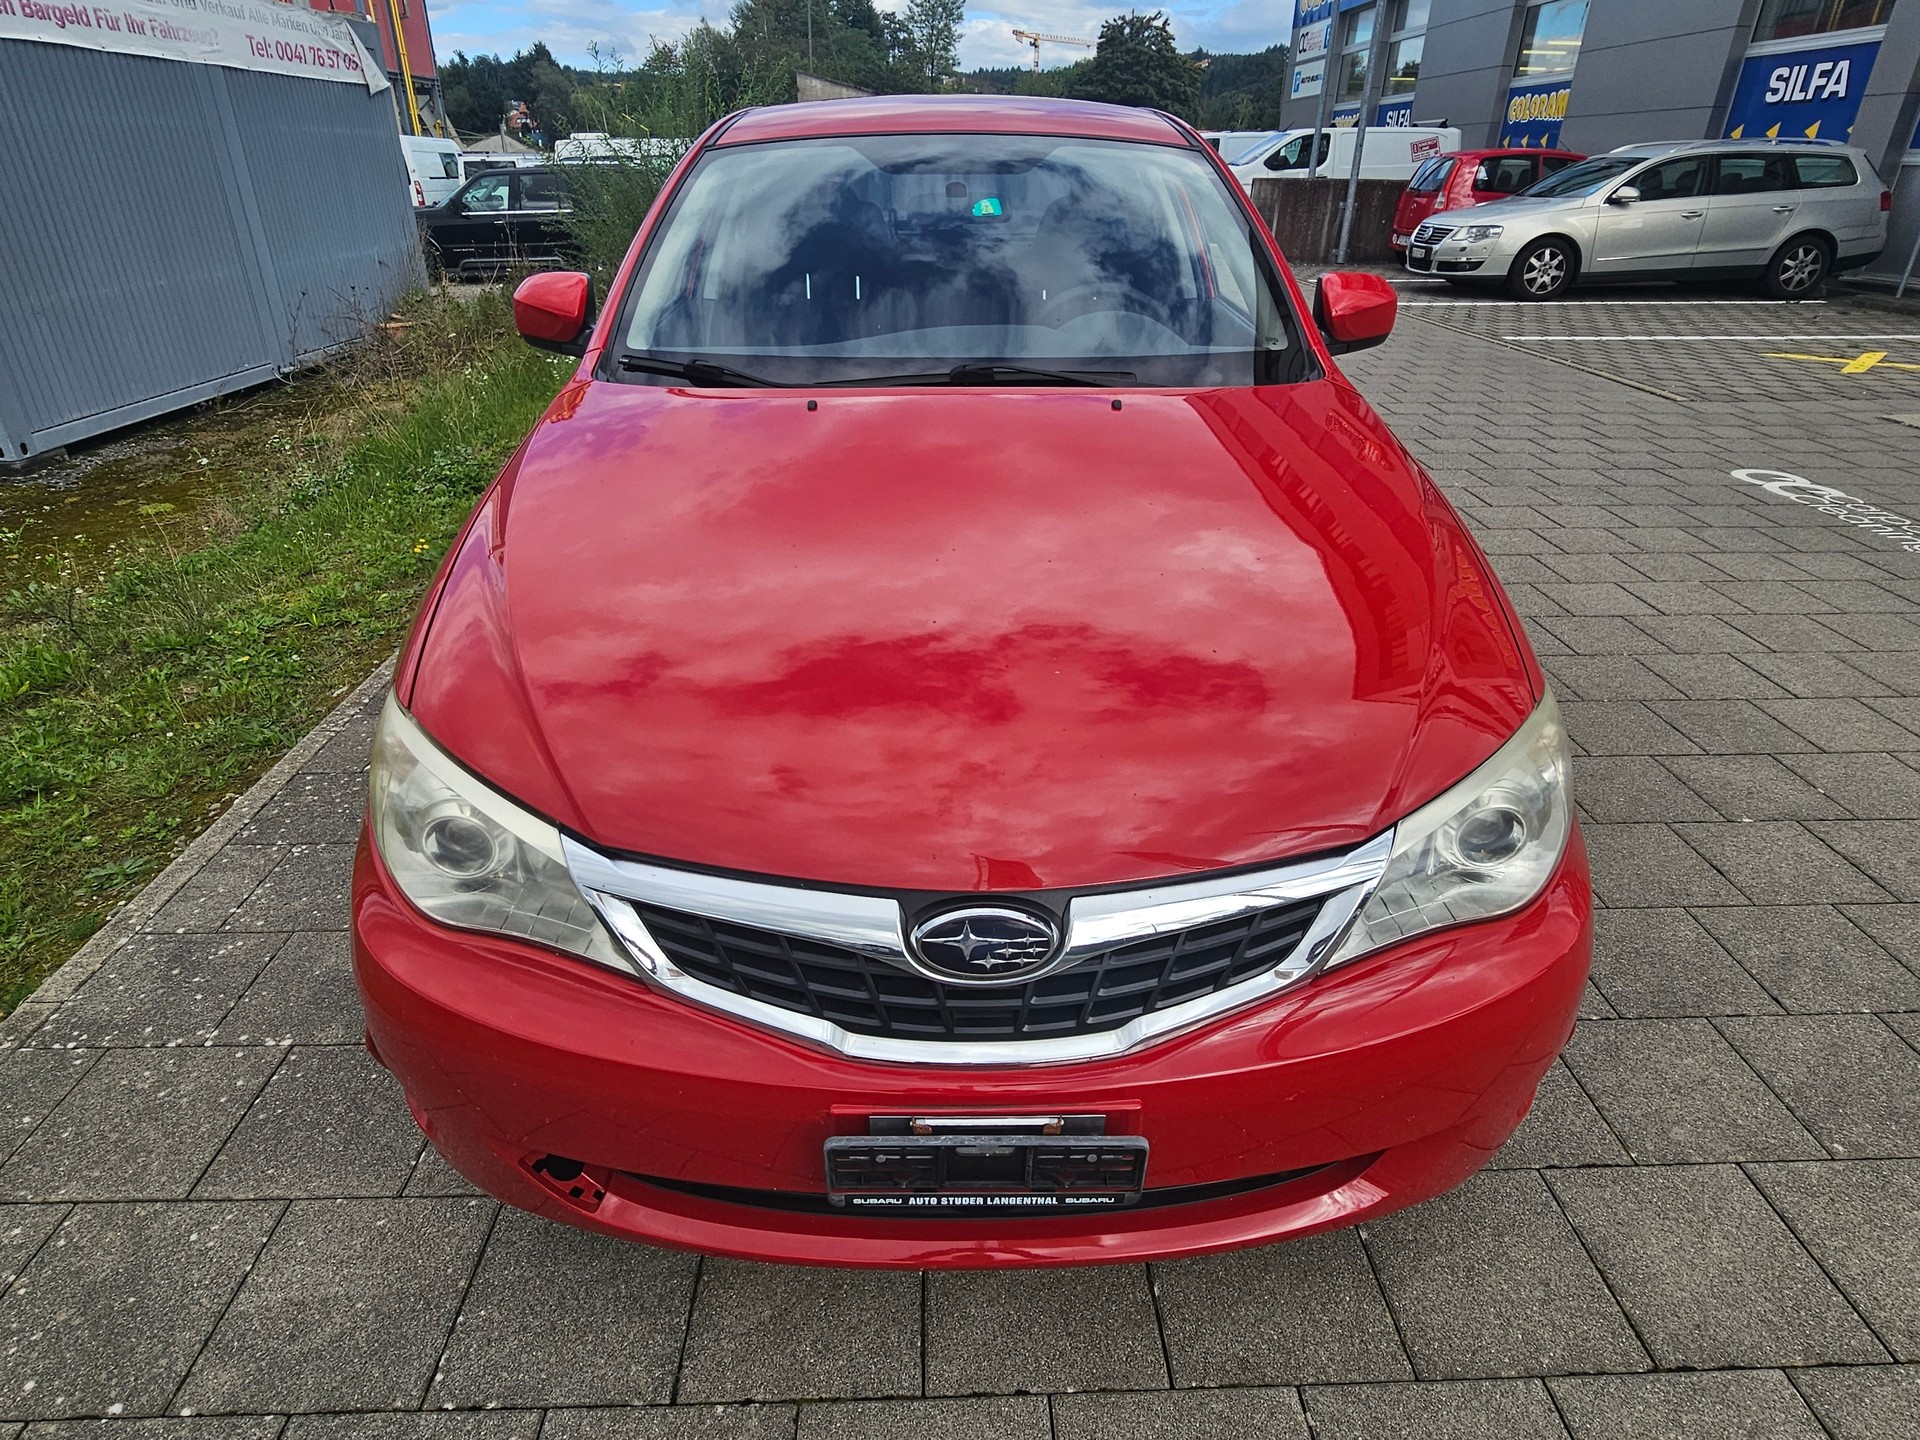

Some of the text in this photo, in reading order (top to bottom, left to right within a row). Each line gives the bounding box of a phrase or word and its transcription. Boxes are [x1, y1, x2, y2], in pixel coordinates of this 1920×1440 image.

[17, 0, 92, 29] Bargeld
[93, 6, 121, 32] Für
[123, 13, 147, 36] Ihr
[200, 0, 246, 20] Verkauf
[249, 8, 269, 26] Alle
[271, 12, 309, 33] Marken
[245, 34, 273, 59] Tel:
[275, 40, 307, 65] 0041
[308, 46, 325, 67] 76
[1765, 60, 1850, 103] SILFA
[1385, 109, 1411, 128] SILFA
[908, 1196, 937, 1205] AUTO
[941, 1196, 984, 1205] STUDER
[987, 1196, 1058, 1205] LANGENTHAL
